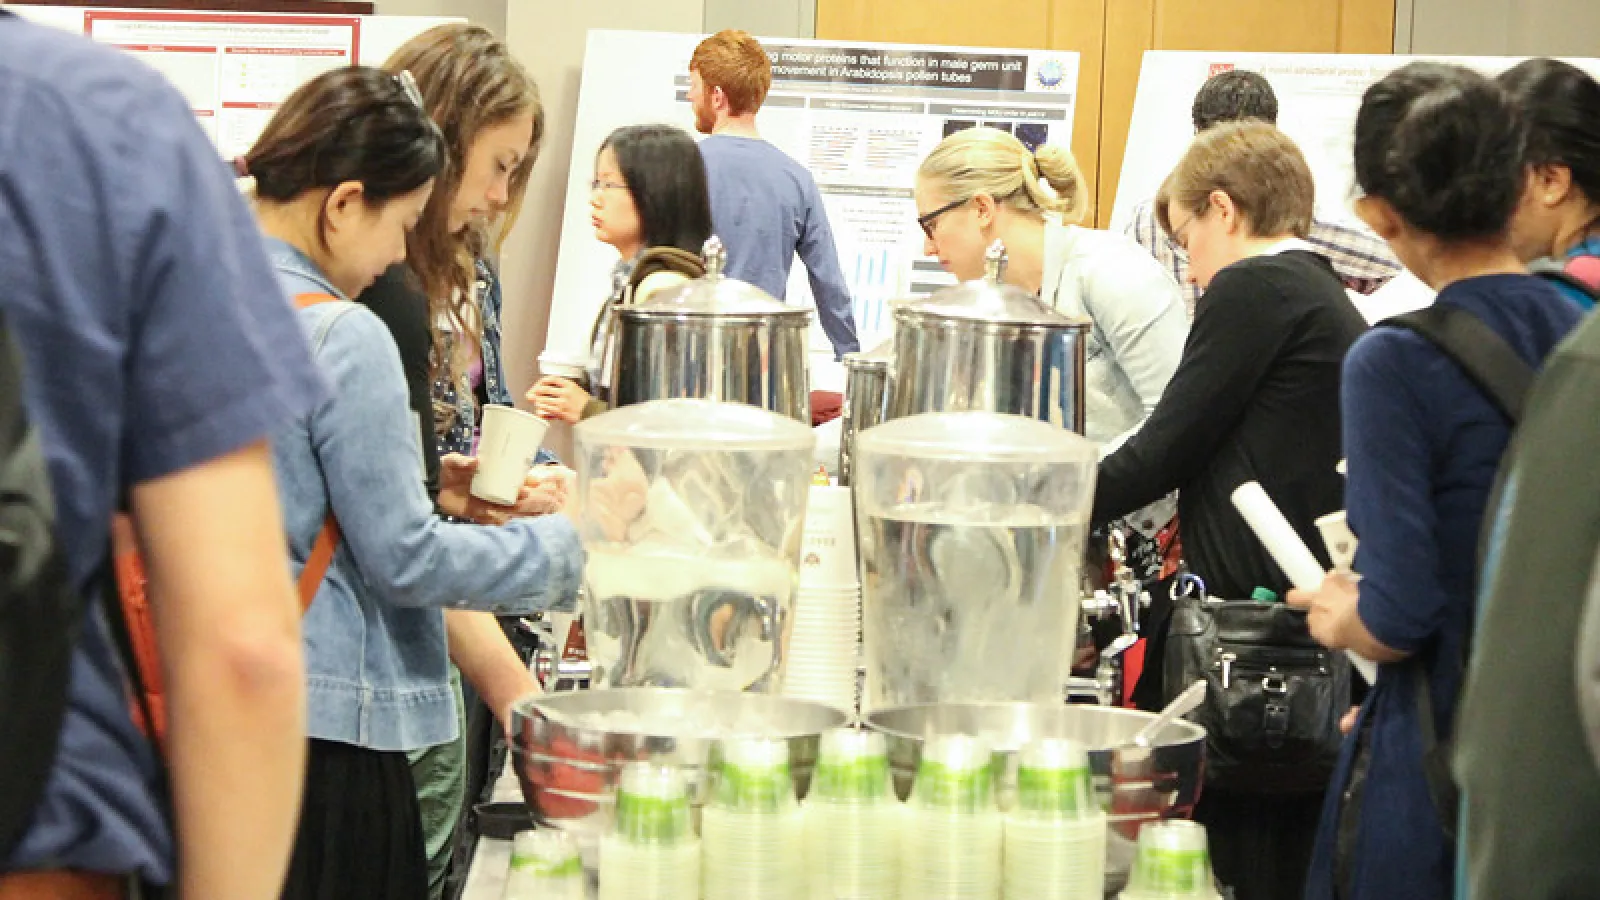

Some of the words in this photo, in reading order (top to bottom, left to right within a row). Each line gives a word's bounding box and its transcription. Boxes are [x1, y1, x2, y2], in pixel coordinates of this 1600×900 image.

[781, 52, 812, 62] motor
[814, 53, 857, 64] proteins
[859, 55, 880, 65] that
[884, 56, 925, 67] function
[927, 56, 938, 67] in
[940, 58, 968, 69] male
[970, 61, 998, 72] germ
[1002, 60, 1022, 71] unit
[772, 66, 826, 76] movement
[828, 67, 838, 76] in
[840, 66, 903, 80] Arabidopsis
[905, 71, 938, 82] pollen
[941, 72, 972, 82] tubes
